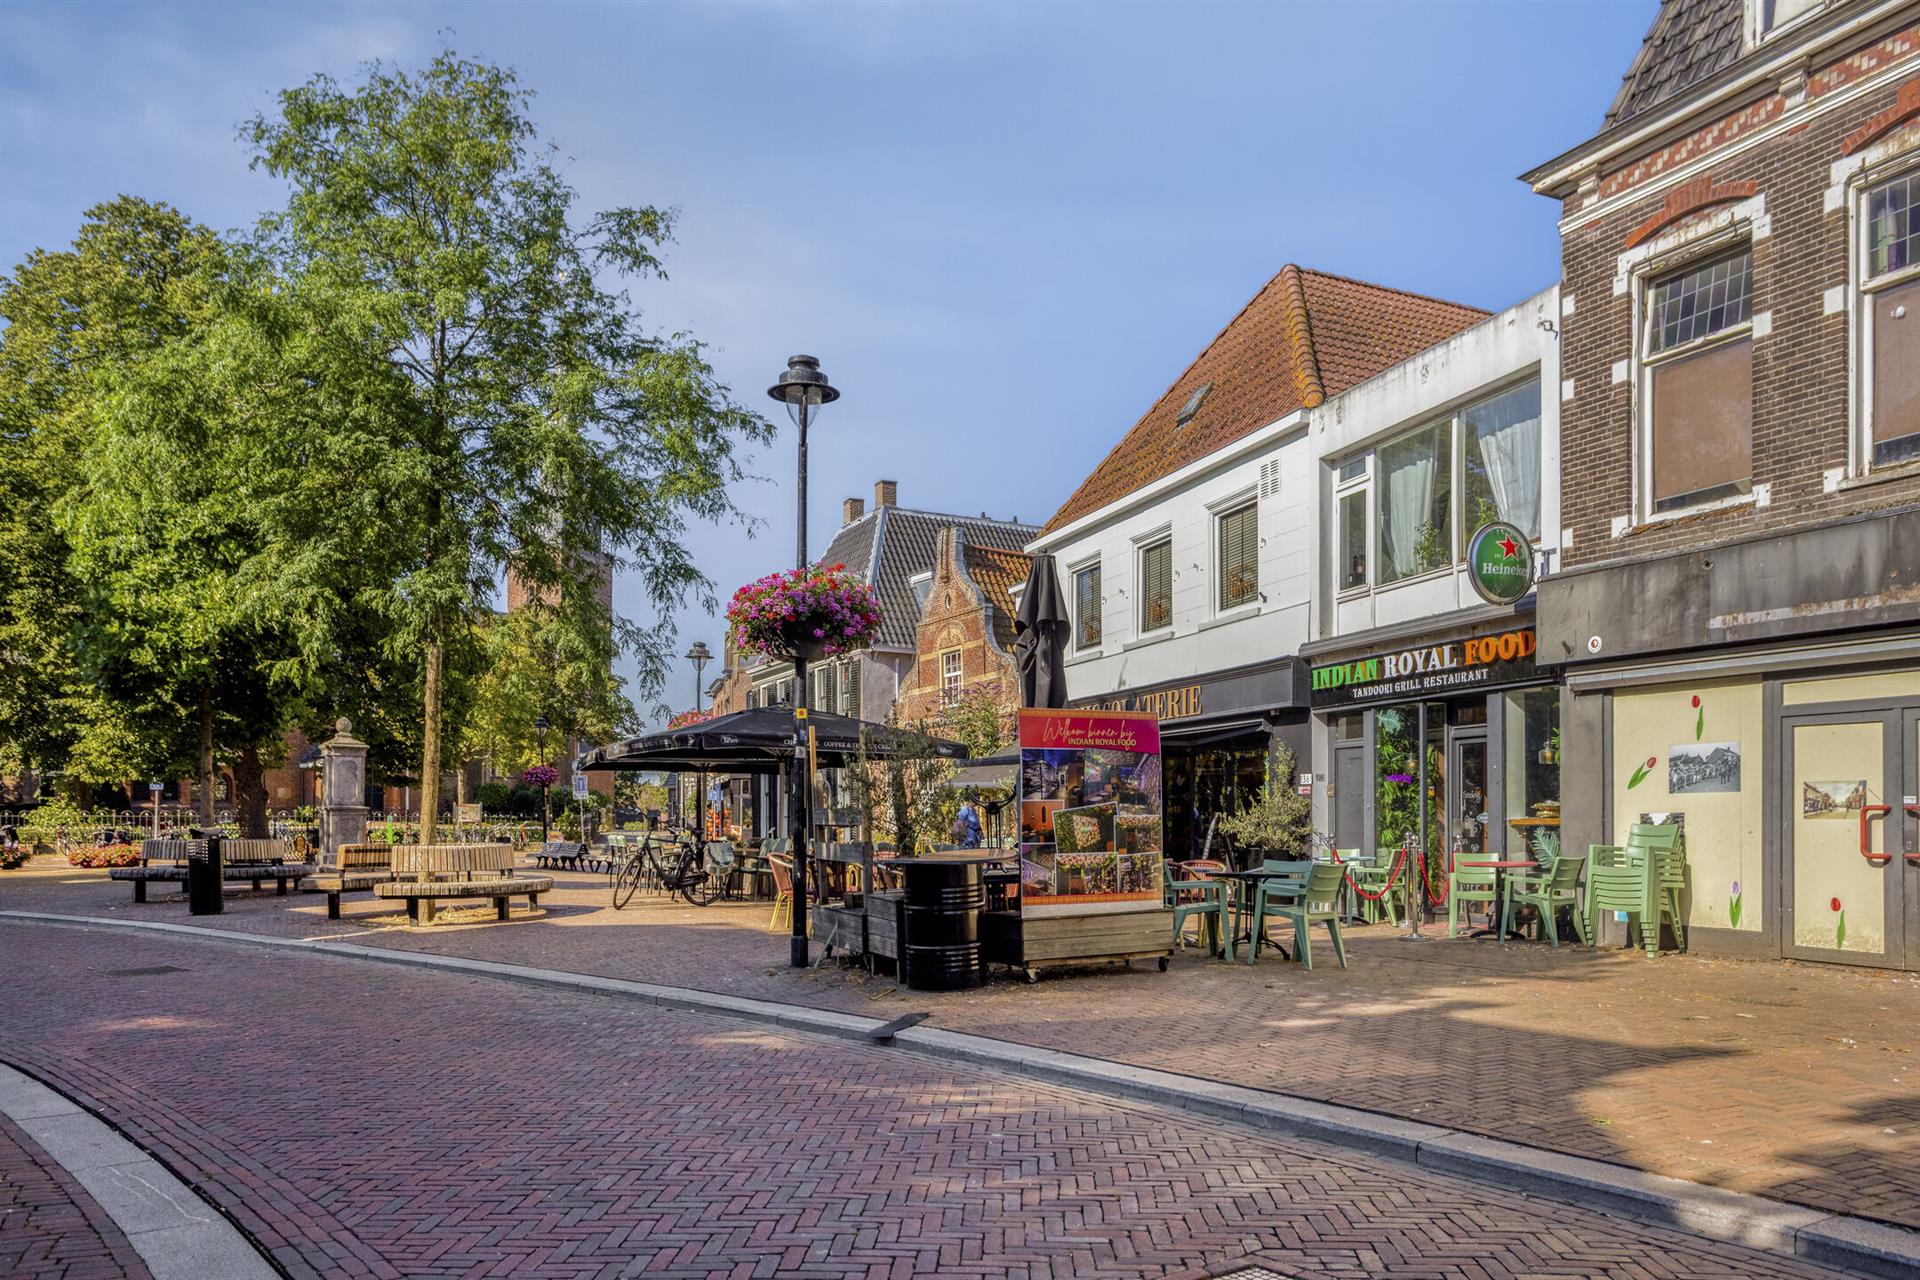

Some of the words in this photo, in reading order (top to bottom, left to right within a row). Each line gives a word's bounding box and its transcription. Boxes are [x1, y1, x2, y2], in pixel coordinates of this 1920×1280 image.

[1482, 562, 1527, 577] Heineke
[1311, 658, 1378, 690] INDIAN
[1384, 644, 1457, 679] ROYAL
[1464, 631, 1536, 666] FOOD
[1353, 684, 1393, 698] TANDOORI
[1394, 679, 1421, 692] GRILL
[1423, 668, 1489, 689] RESTAURANT
[1074, 685, 1202, 721] ATERIE
[1043, 717, 1086, 743] Welkom
[1087, 718, 1118, 739] binnen
[1120, 719, 1136, 750] bij
[1068, 738, 1094, 746] INDIAN
[1095, 738, 1116, 746] ROYAL
[1117, 738, 1137, 747] FOOD
